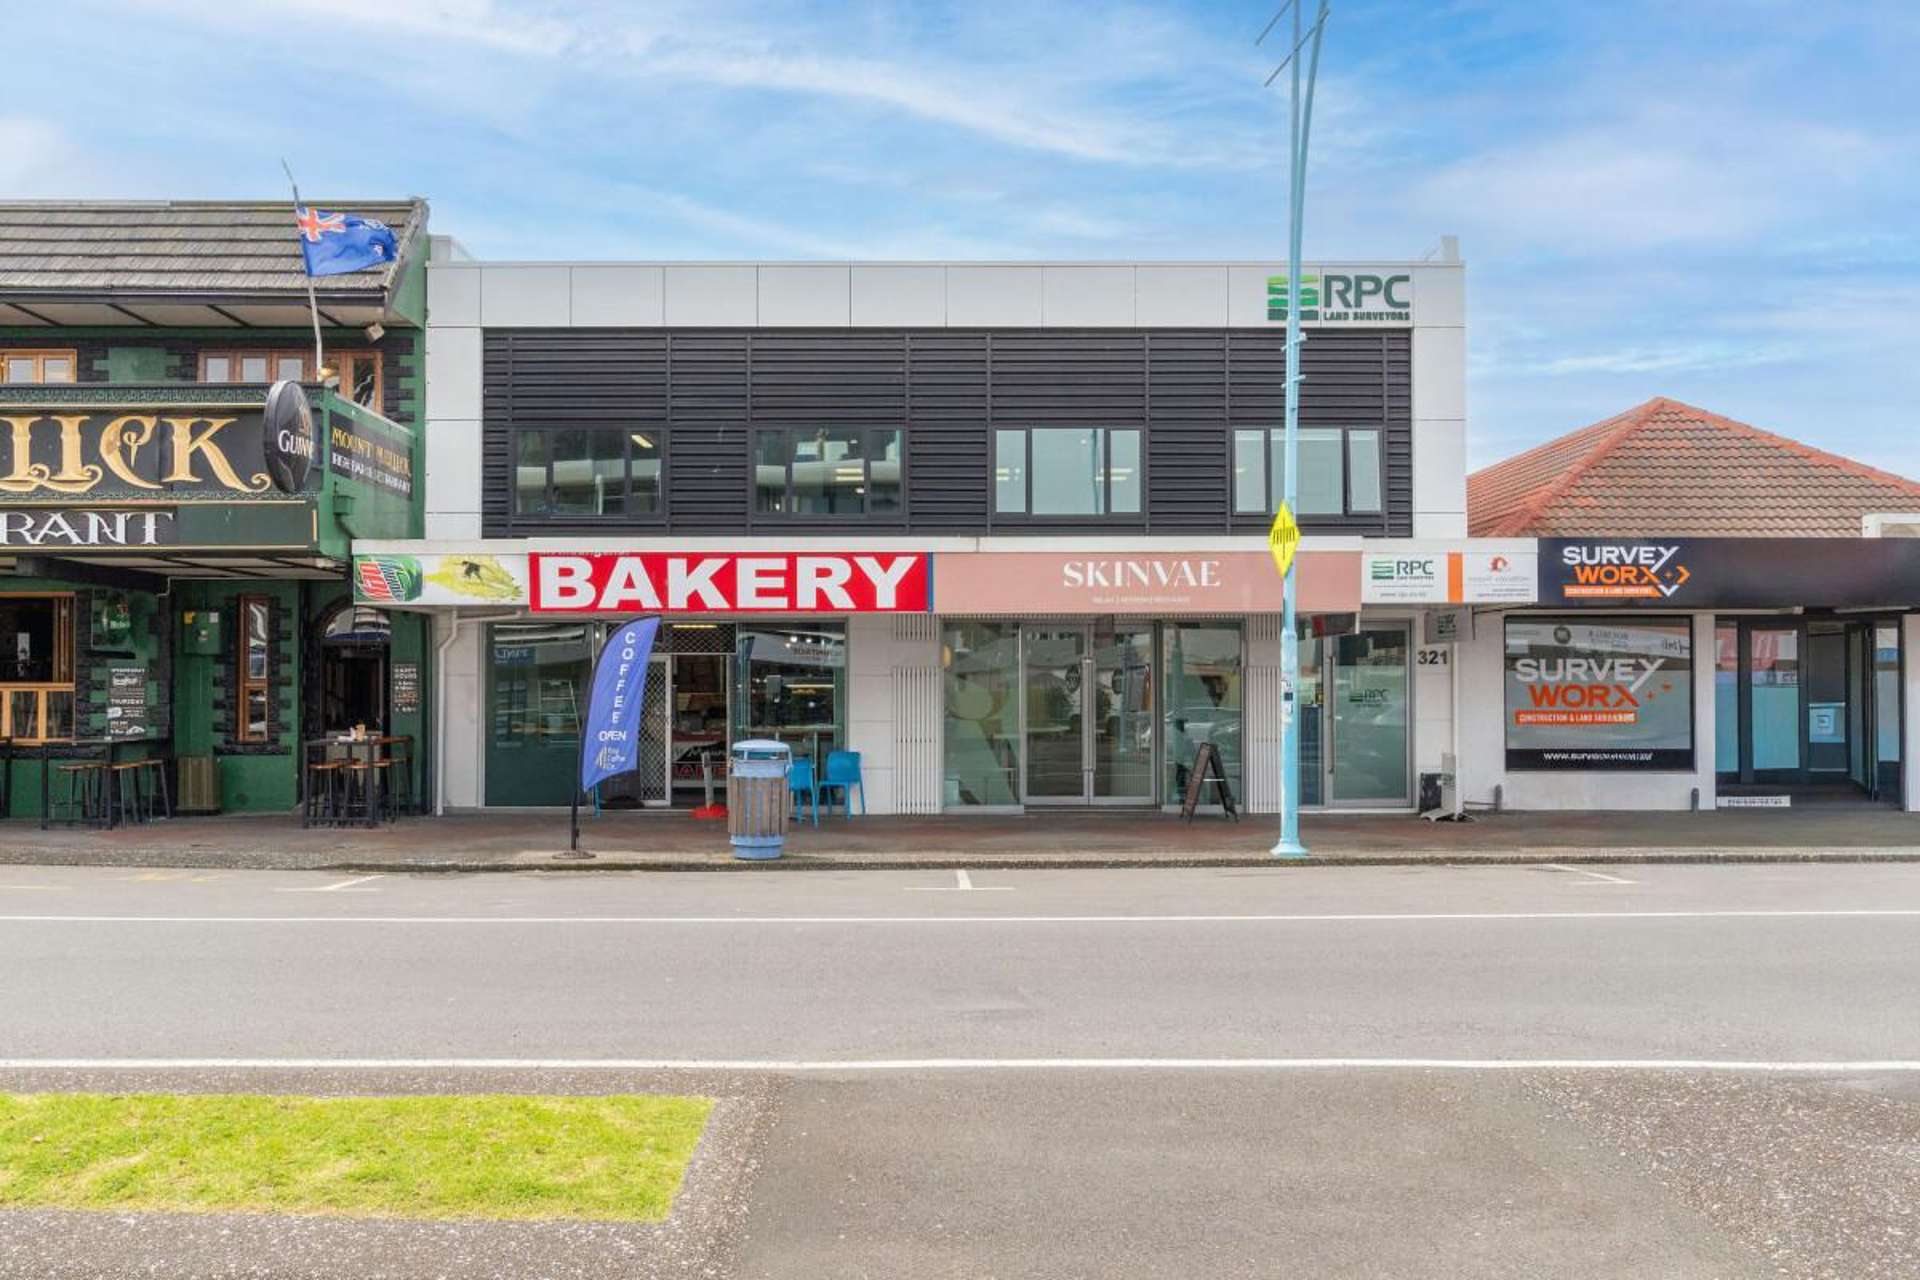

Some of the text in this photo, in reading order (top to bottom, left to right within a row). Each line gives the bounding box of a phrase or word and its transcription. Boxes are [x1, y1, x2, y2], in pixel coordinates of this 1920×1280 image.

[1324, 274, 1410, 309] RPC
[1324, 312, 1410, 321] LAND SURVEYORS
[1396, 560, 1434, 576] RPC
[1562, 545, 1680, 574] SURVEY
[539, 556, 918, 609] BAKERY
[1063, 560, 1221, 588] SKINVAE
[1574, 565, 1662, 585] WORX
[1417, 650, 1448, 665] 321
[611, 631, 637, 725] COFFEE
[1515, 658, 1665, 693] SURVEY
[1529, 682, 1640, 708] WORX
[599, 730, 627, 742] OPEN
